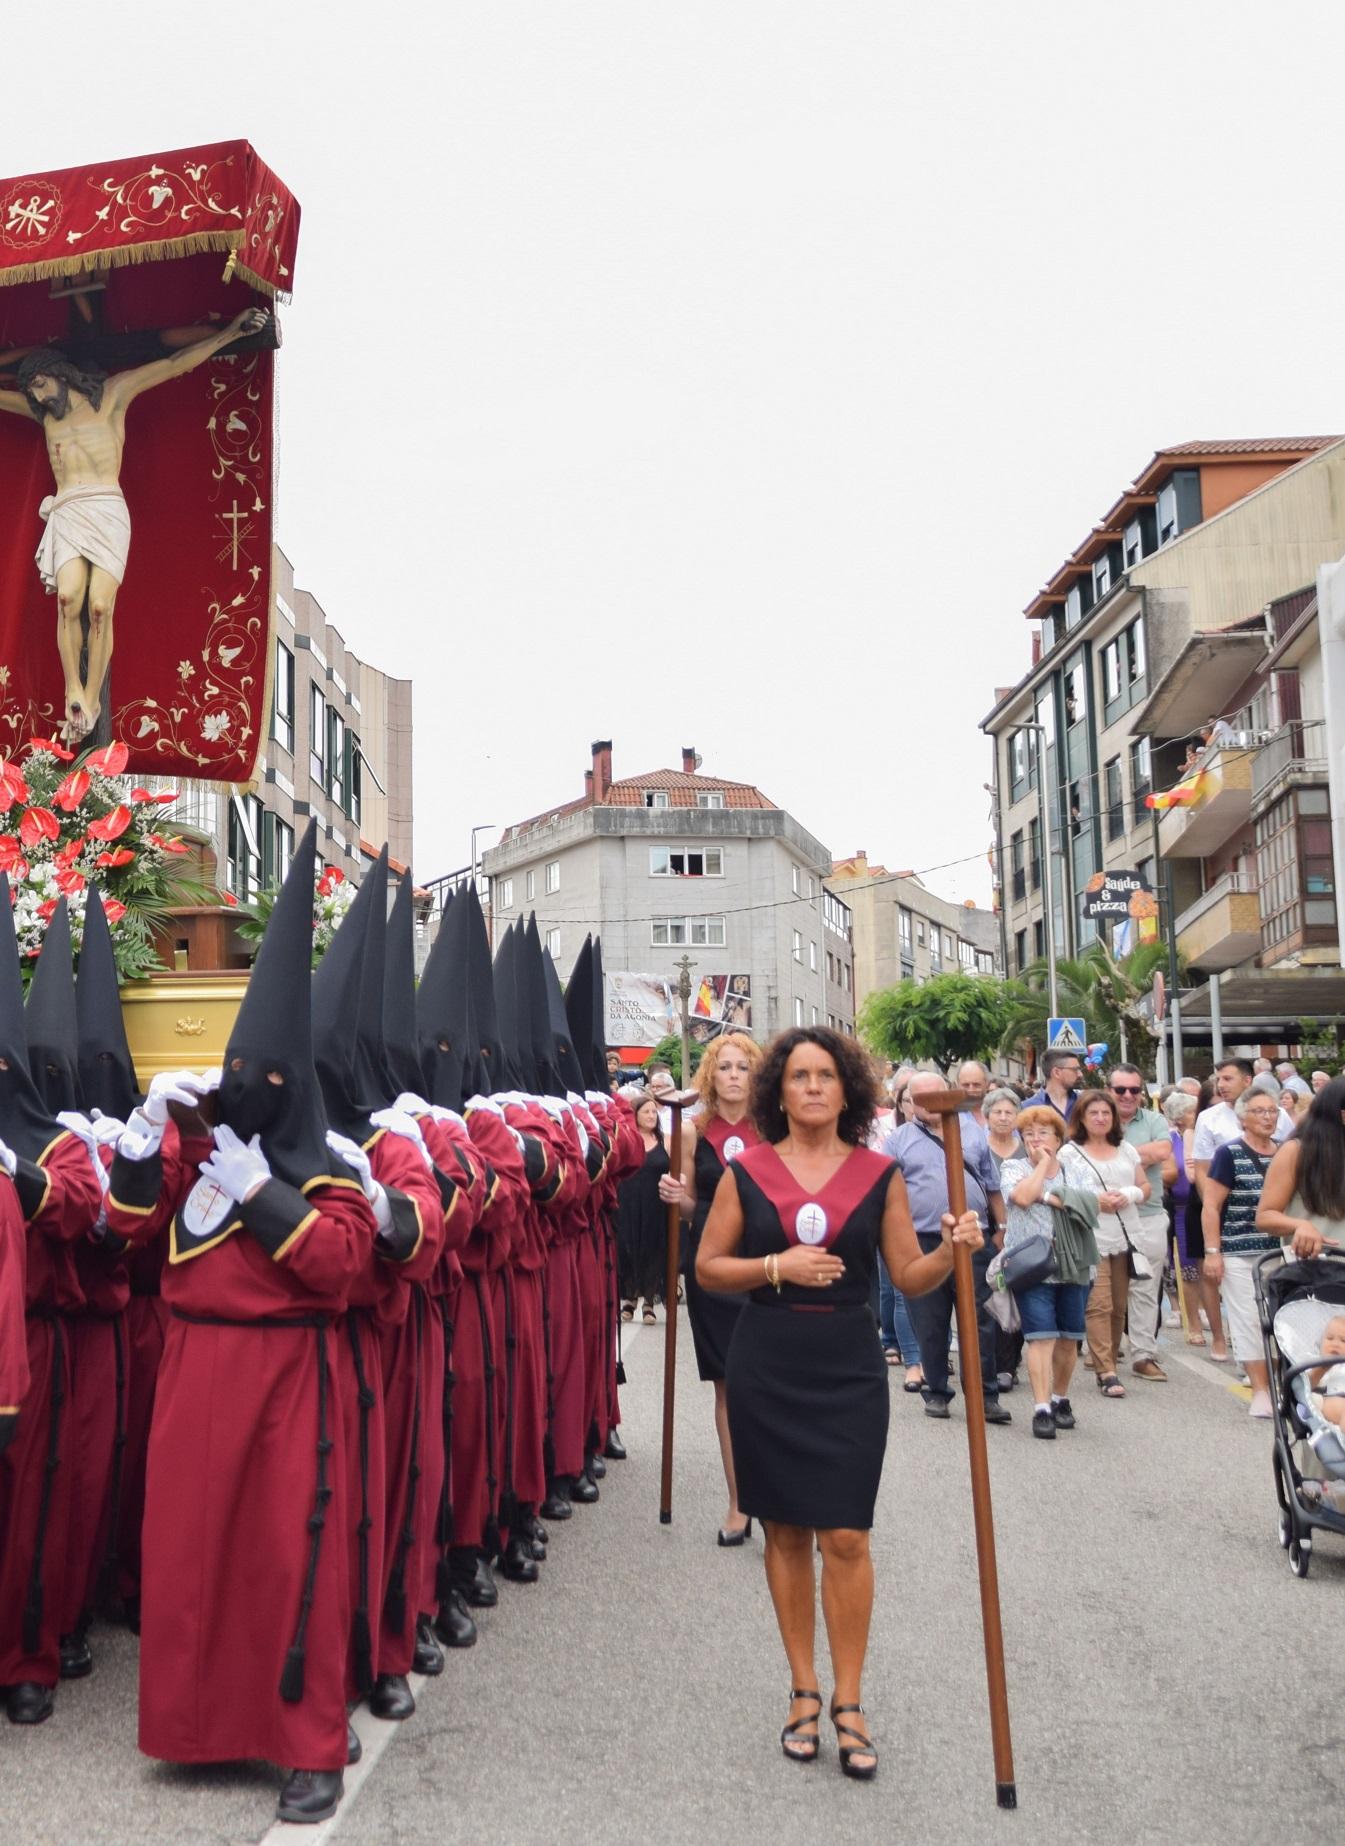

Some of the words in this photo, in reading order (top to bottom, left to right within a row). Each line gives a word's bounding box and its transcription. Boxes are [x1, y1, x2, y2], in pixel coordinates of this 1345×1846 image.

[1101, 889, 1111, 901] &
[1089, 901, 1128, 915] pizza
[610, 999, 639, 1007] SANTO
[610, 1006, 642, 1014] CRISTO
